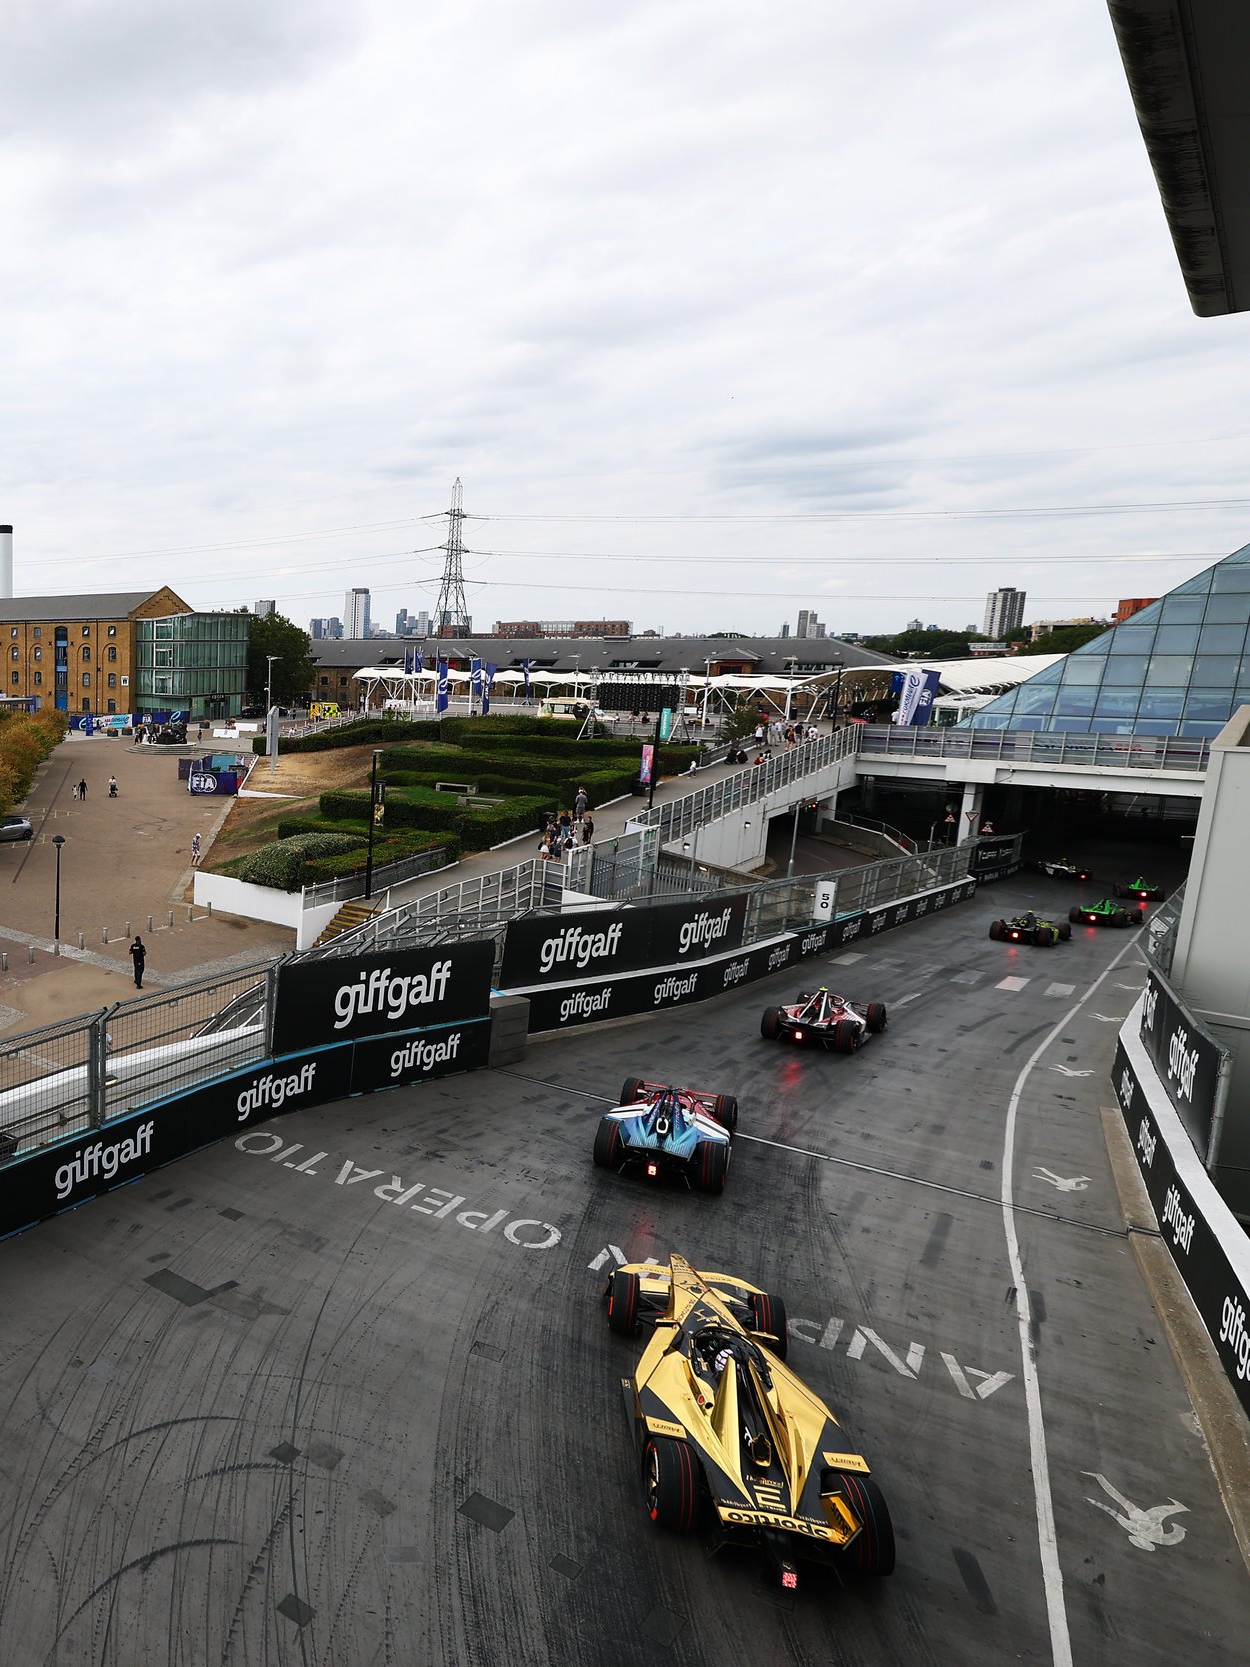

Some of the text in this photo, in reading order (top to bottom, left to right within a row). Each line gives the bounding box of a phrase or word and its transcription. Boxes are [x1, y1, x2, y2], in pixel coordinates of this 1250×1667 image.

[918, 689, 931, 707] FIA
[192, 777, 216, 789] FIA
[820, 893, 830, 909] 50
[540, 923, 622, 973] giffgaff
[679, 908, 731, 953] giffgaff
[802, 930, 827, 955] giffgaff
[723, 958, 750, 987] giffgaff
[768, 944, 791, 971] giffgaff
[334, 960, 452, 1029] giffgaff
[560, 988, 612, 1021] giffgaff
[654, 973, 698, 1004] giffgaff
[390, 1033, 461, 1077] giffgaff
[1168, 1025, 1199, 1103] giffgaff
[237, 1063, 316, 1121] giffgaff
[55, 1121, 154, 1199] giffgaff
[234, 1131, 563, 1249] OPERATIO
[1162, 1184, 1195, 1255] giffgaff
[786, 1316, 1016, 1400] ANP
[1219, 1296, 1250, 1380] giffg
